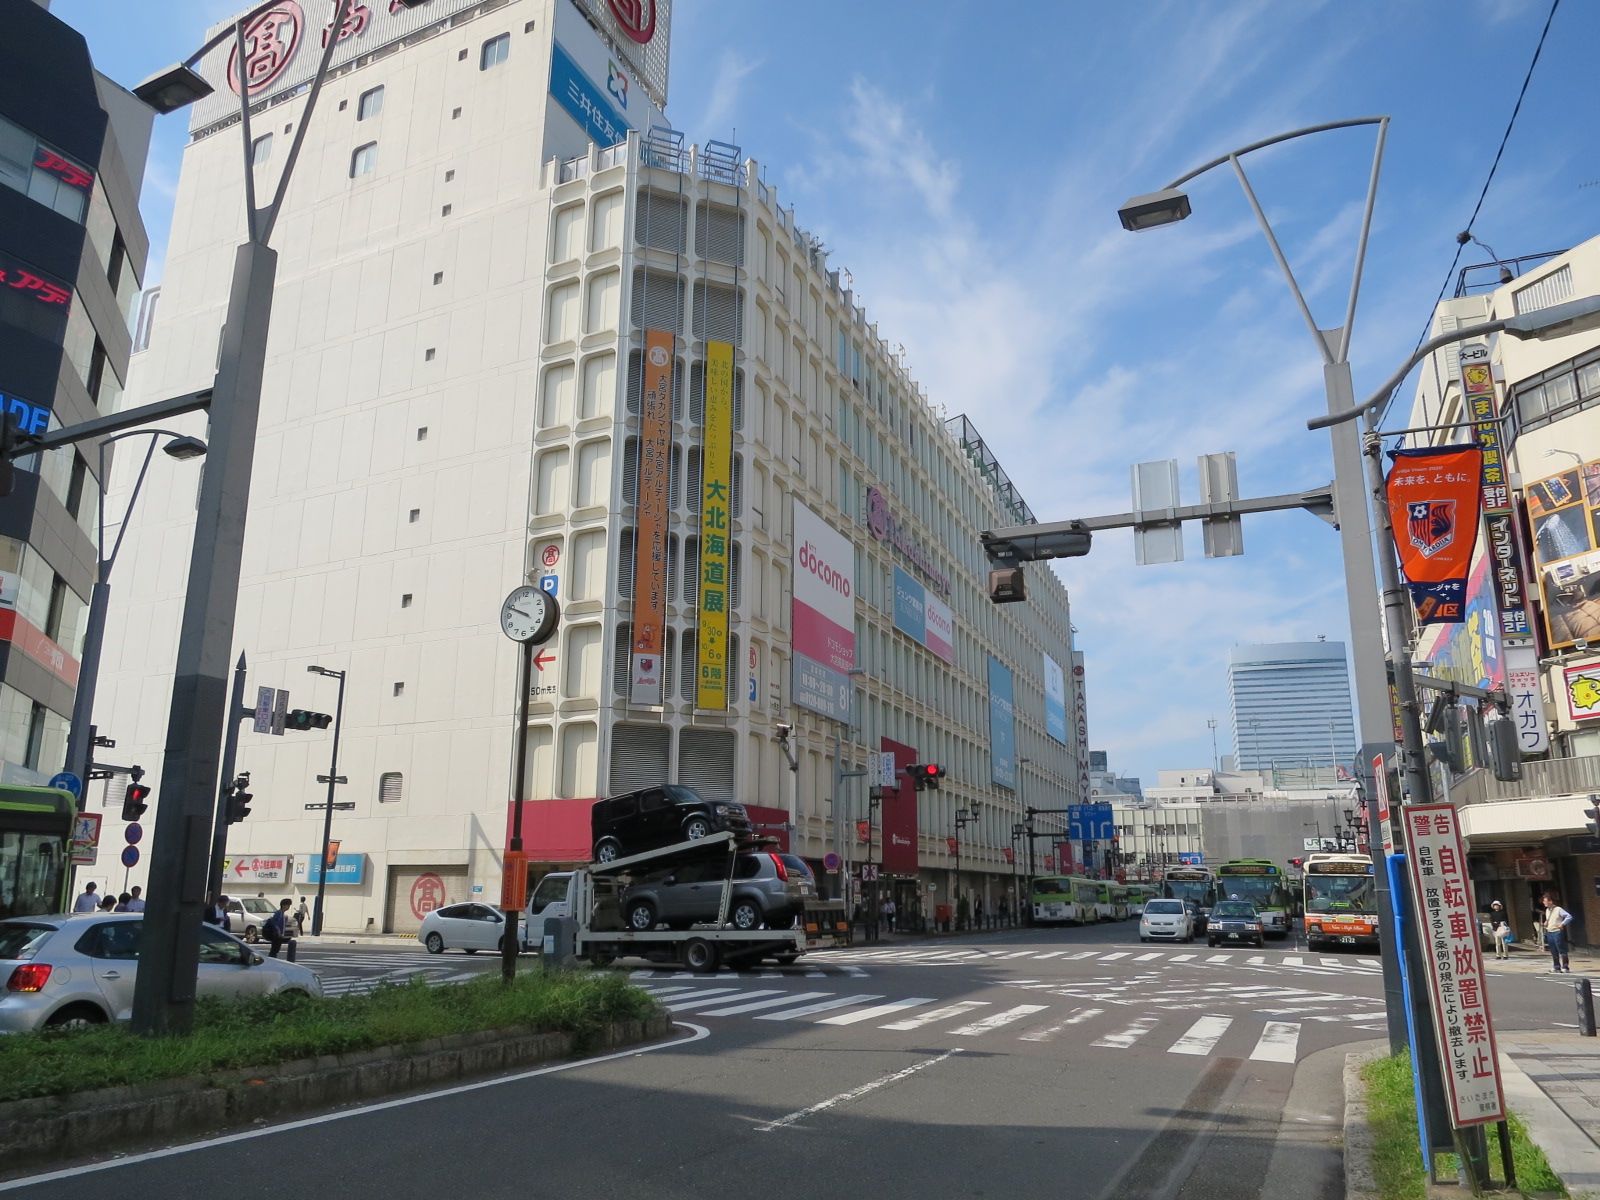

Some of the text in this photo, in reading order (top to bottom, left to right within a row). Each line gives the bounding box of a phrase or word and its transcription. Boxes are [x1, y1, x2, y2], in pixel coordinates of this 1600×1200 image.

[1474, 399, 1501, 483] まんが喫茶
[1393, 473, 1471, 487] 未来を、ともに。
[1485, 497, 1508, 508] 3F
[703, 479, 727, 613] 大北海道展
[799, 540, 850, 598] docomo
[1490, 516, 1521, 609] インターネット
[543, 579, 555, 591] P
[927, 605, 950, 634] docomo
[1502, 610, 1525, 622] 受付
[1504, 622, 1526, 633] 2F
[1508, 638, 1527, 646] 地下
[1516, 690, 1540, 748] オガワ
[1075, 680, 1090, 804] TAKASHIMAYA
[1413, 813, 1450, 836] 警告
[1306, 838, 1319, 846] JR
[1418, 845, 1470, 1083] 自転車 放置すると条例の規定により撤去します。
[1438, 845, 1493, 1079] 自転車放置禁止
